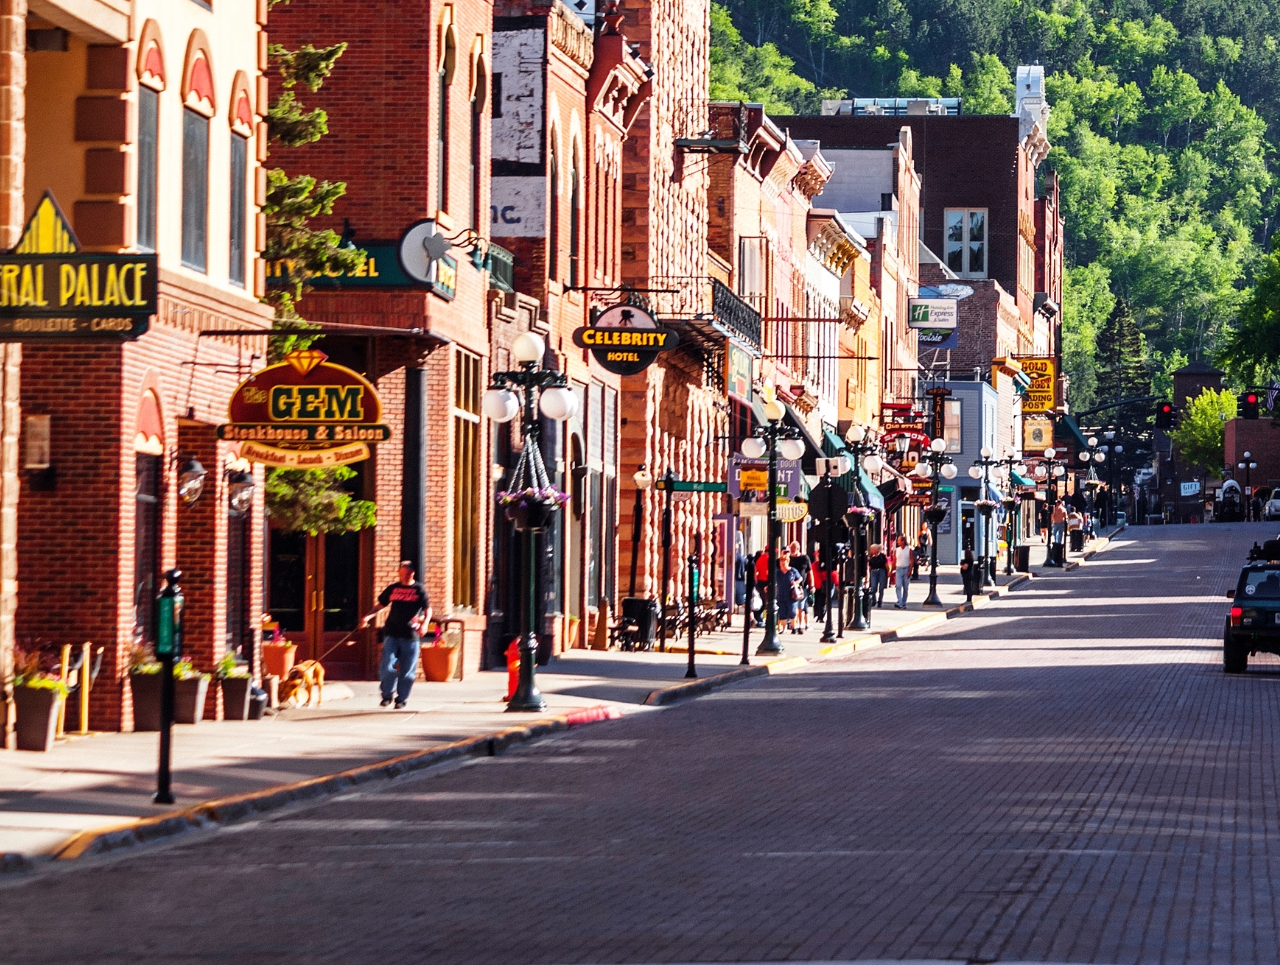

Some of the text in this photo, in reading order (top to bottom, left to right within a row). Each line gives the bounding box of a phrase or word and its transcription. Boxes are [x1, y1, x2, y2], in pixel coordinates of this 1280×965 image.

[59, 262, 148, 308] PALACE
[929, 309, 954, 318] Express
[90, 318, 134, 332] CARDS
[582, 329, 668, 347] CELEBRITY
[607, 351, 640, 362] HOTEL
[1022, 361, 1048, 373] GOLD
[269, 385, 365, 422] GEM
[1022, 401, 1046, 410] POST
[222, 425, 385, 440] Steakhouse & Saloon
[1183, 483, 1199, 491] GIFT
[776, 504, 805, 519] HOTOS
